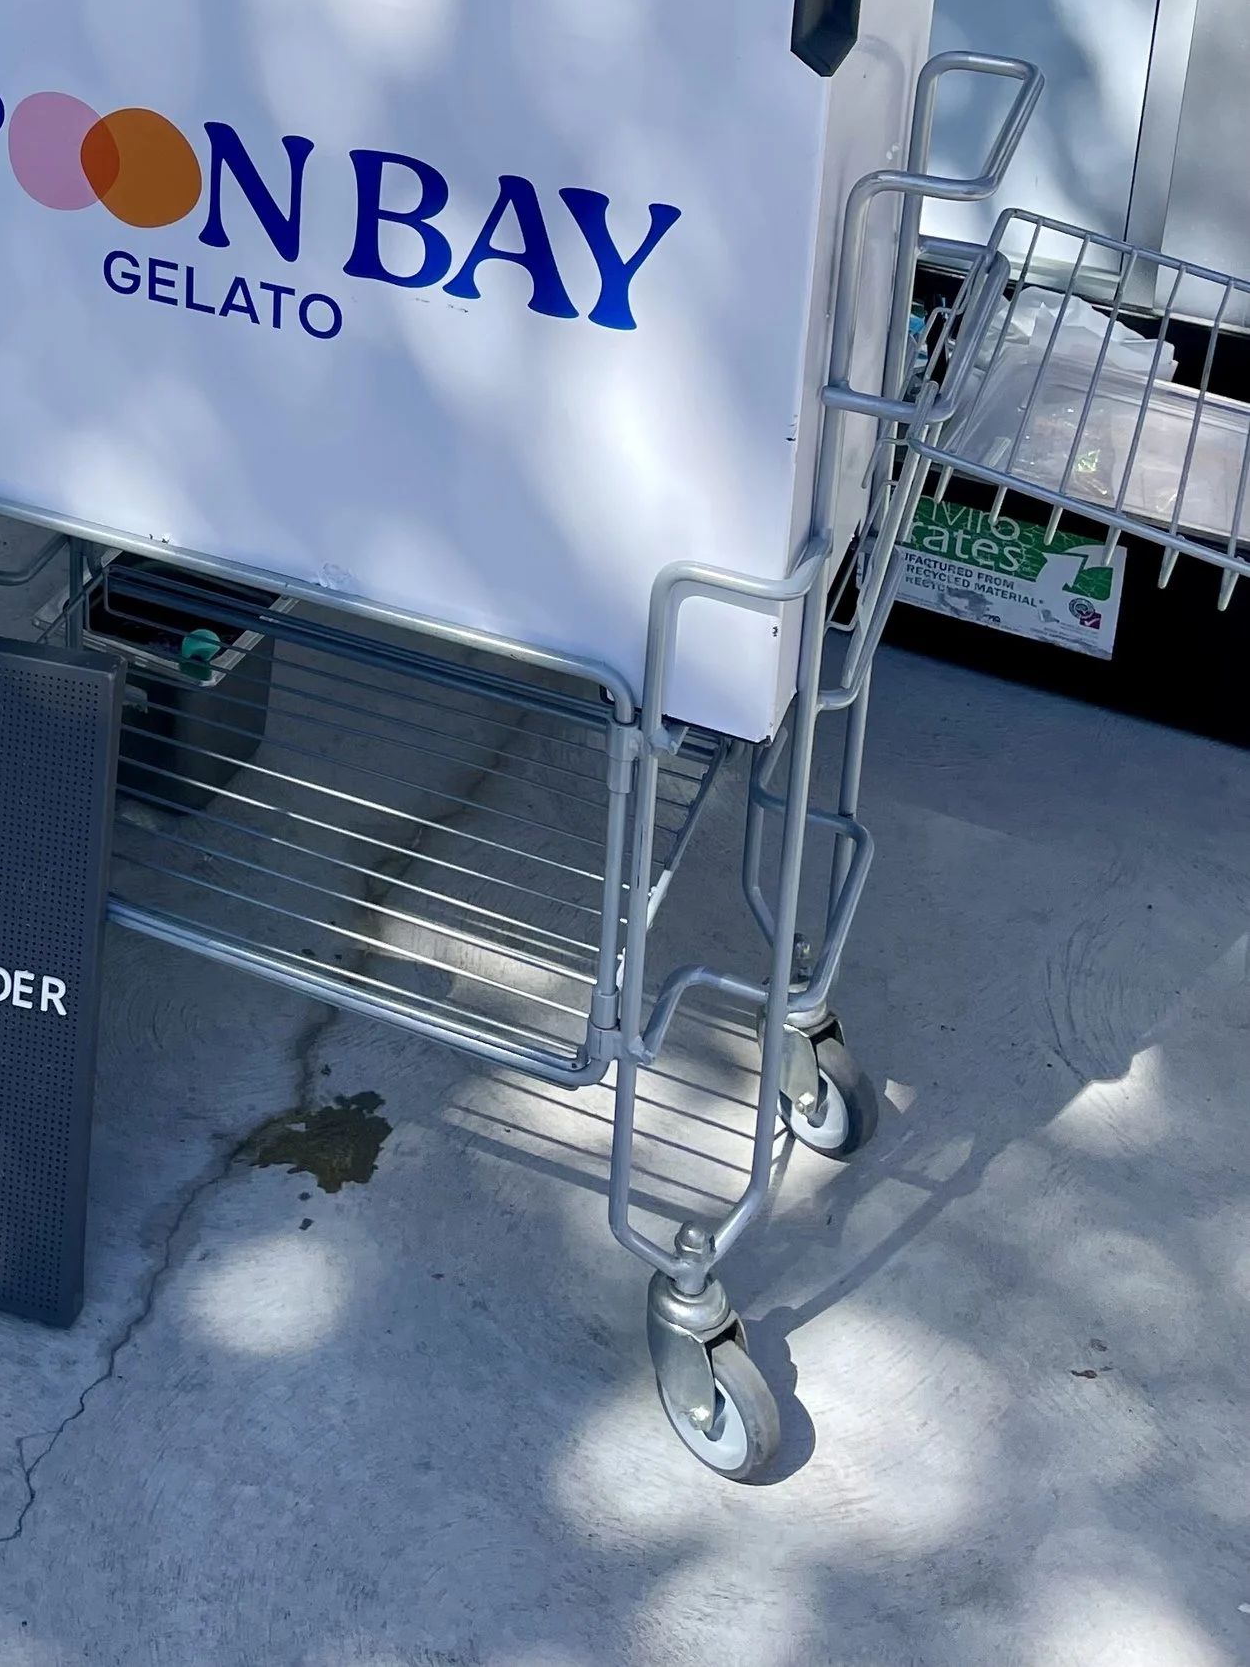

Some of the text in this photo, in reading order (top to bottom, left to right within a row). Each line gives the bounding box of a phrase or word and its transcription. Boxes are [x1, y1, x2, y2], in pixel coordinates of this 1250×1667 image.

[343, 150, 681, 331] BAY
[102, 250, 343, 340] GELATO
[906, 563, 971, 589] RECYCLED
[977, 570, 1015, 590] FROM
